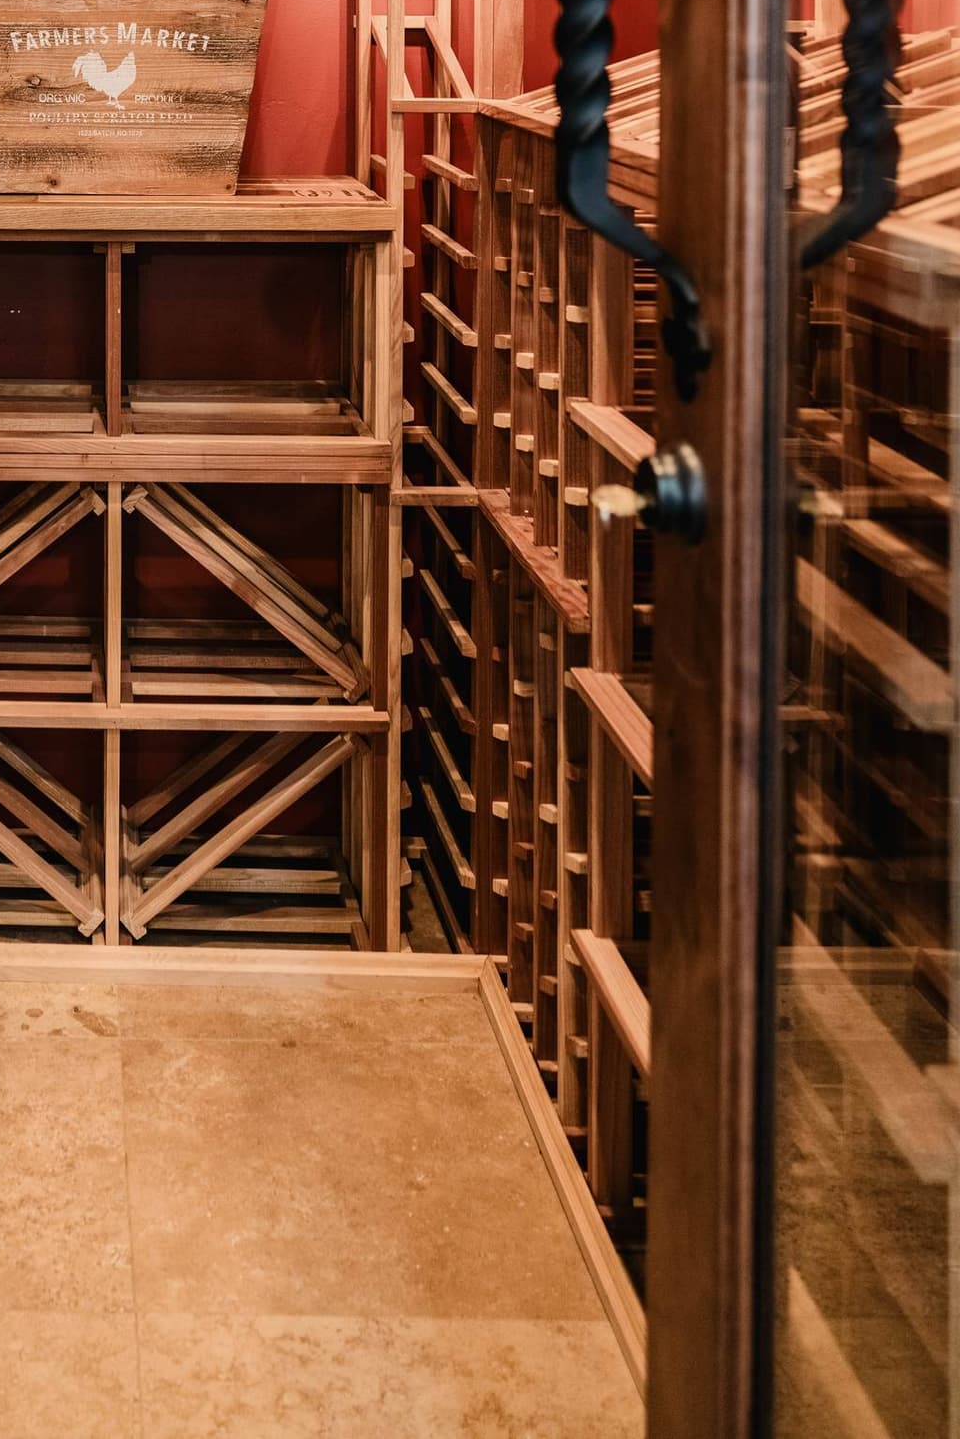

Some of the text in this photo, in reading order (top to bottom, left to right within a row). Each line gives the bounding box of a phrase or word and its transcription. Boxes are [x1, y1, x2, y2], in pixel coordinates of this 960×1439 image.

[10, 22, 210, 52] FARMERS MARKET
[94, 112, 155, 123] SCRATCH
